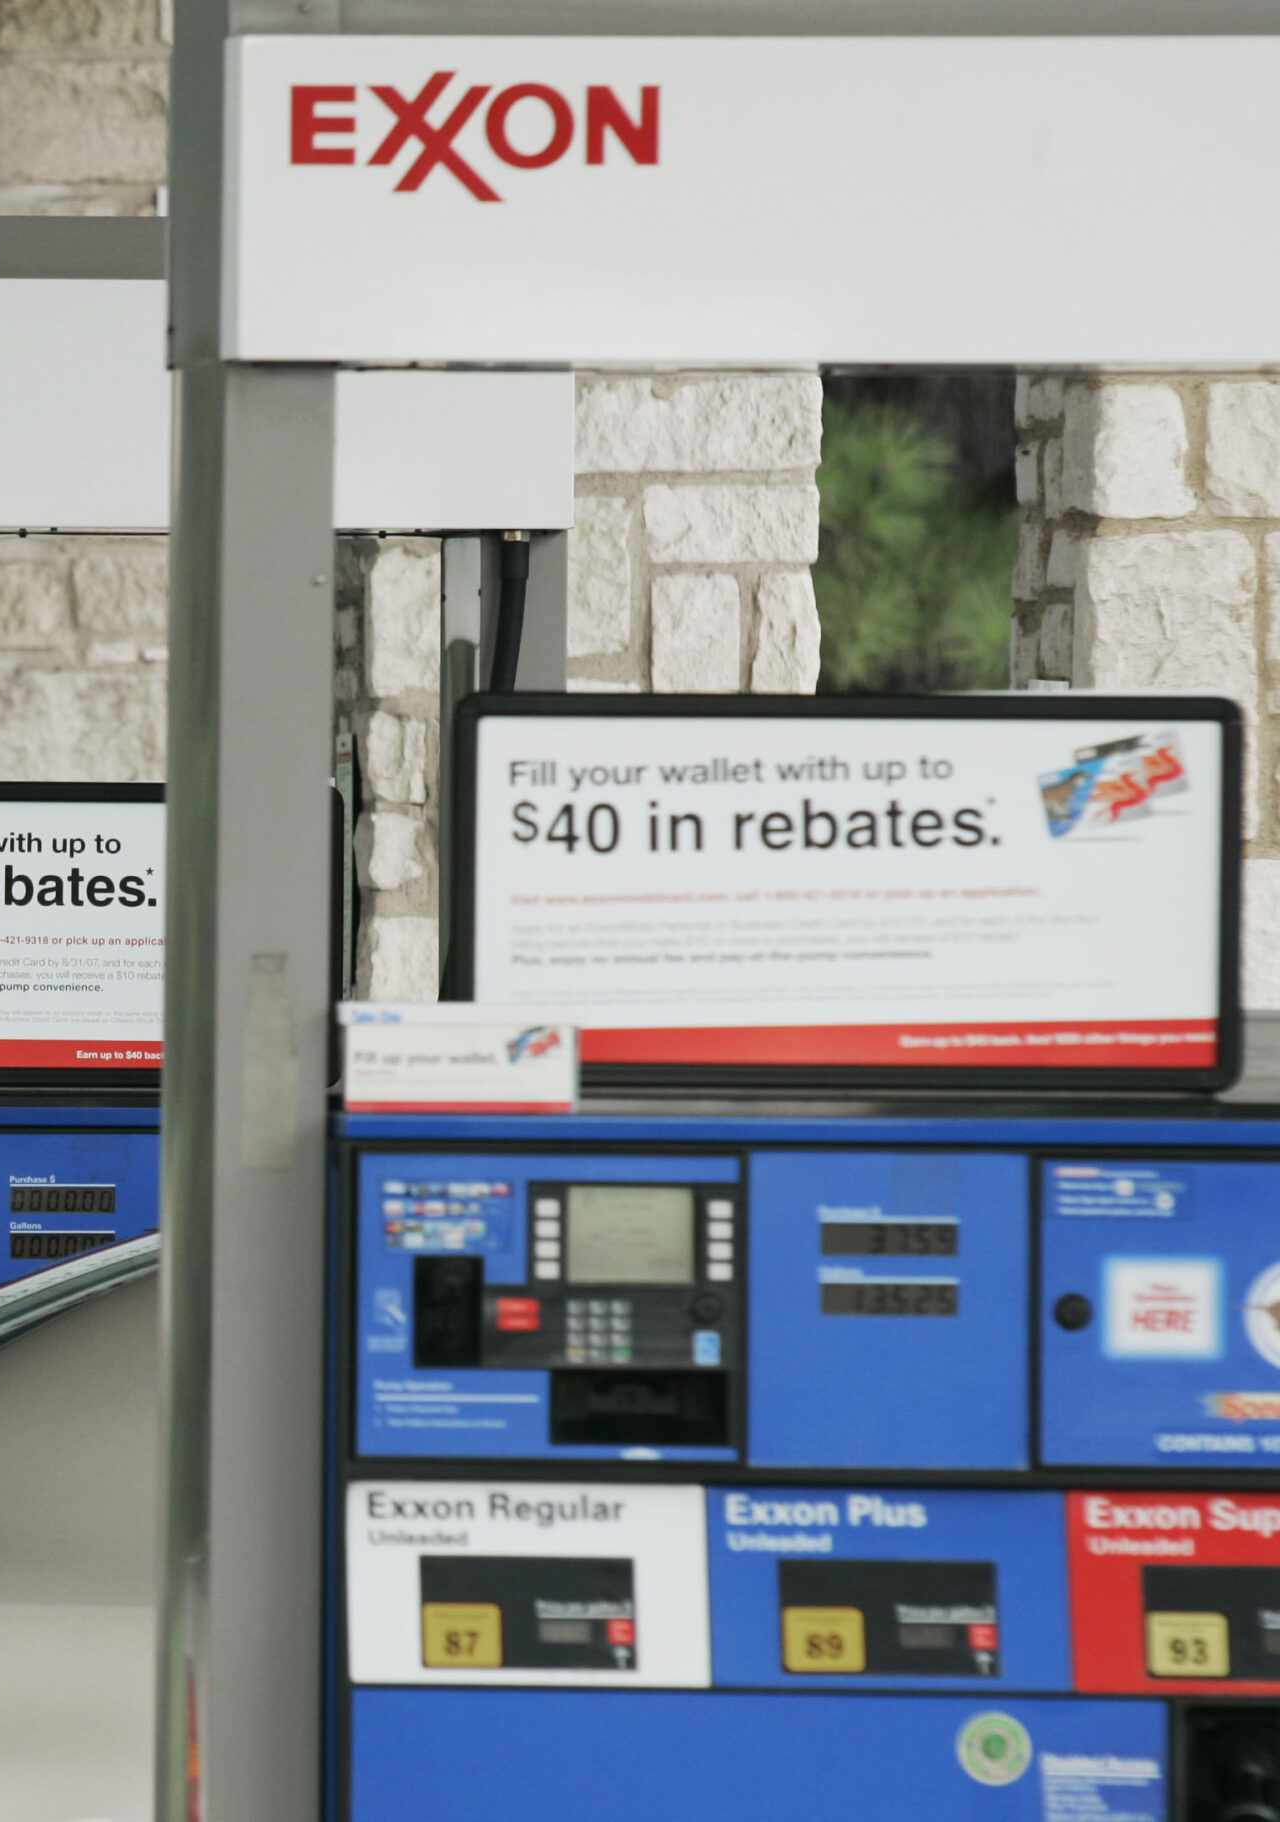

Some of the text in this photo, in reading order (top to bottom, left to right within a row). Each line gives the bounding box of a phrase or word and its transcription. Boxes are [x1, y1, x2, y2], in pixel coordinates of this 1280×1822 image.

[290, 71, 661, 202] EXXON
[509, 756, 953, 792] Fill your wallet with up to
[512, 800, 620, 854] $40
[649, 800, 704, 852] in
[52, 838, 85, 857] up
[95, 834, 121, 853] to
[51, 937, 62, 945] or
[66, 936, 88, 947] pick
[91, 937, 105, 947] up
[108, 938, 121, 946] an
[124, 936, 166, 948] applica
[32, 984, 104, 992] convenience.
[76, 1049, 98, 1060] Earn
[100, 1051, 112, 1061] up
[114, 1050, 124, 1059] to
[126, 1050, 143, 1060] $40
[9, 1175, 48, 1184] Purchase
[9, 1221, 42, 1230] Gallons
[367, 1492, 626, 1527] Exxon Regular
[725, 1494, 929, 1528] Exxon Plus
[1084, 1496, 1202, 1530] Exxon
[445, 1631, 480, 1657] 87
[1170, 1637, 1210, 1666] 93
